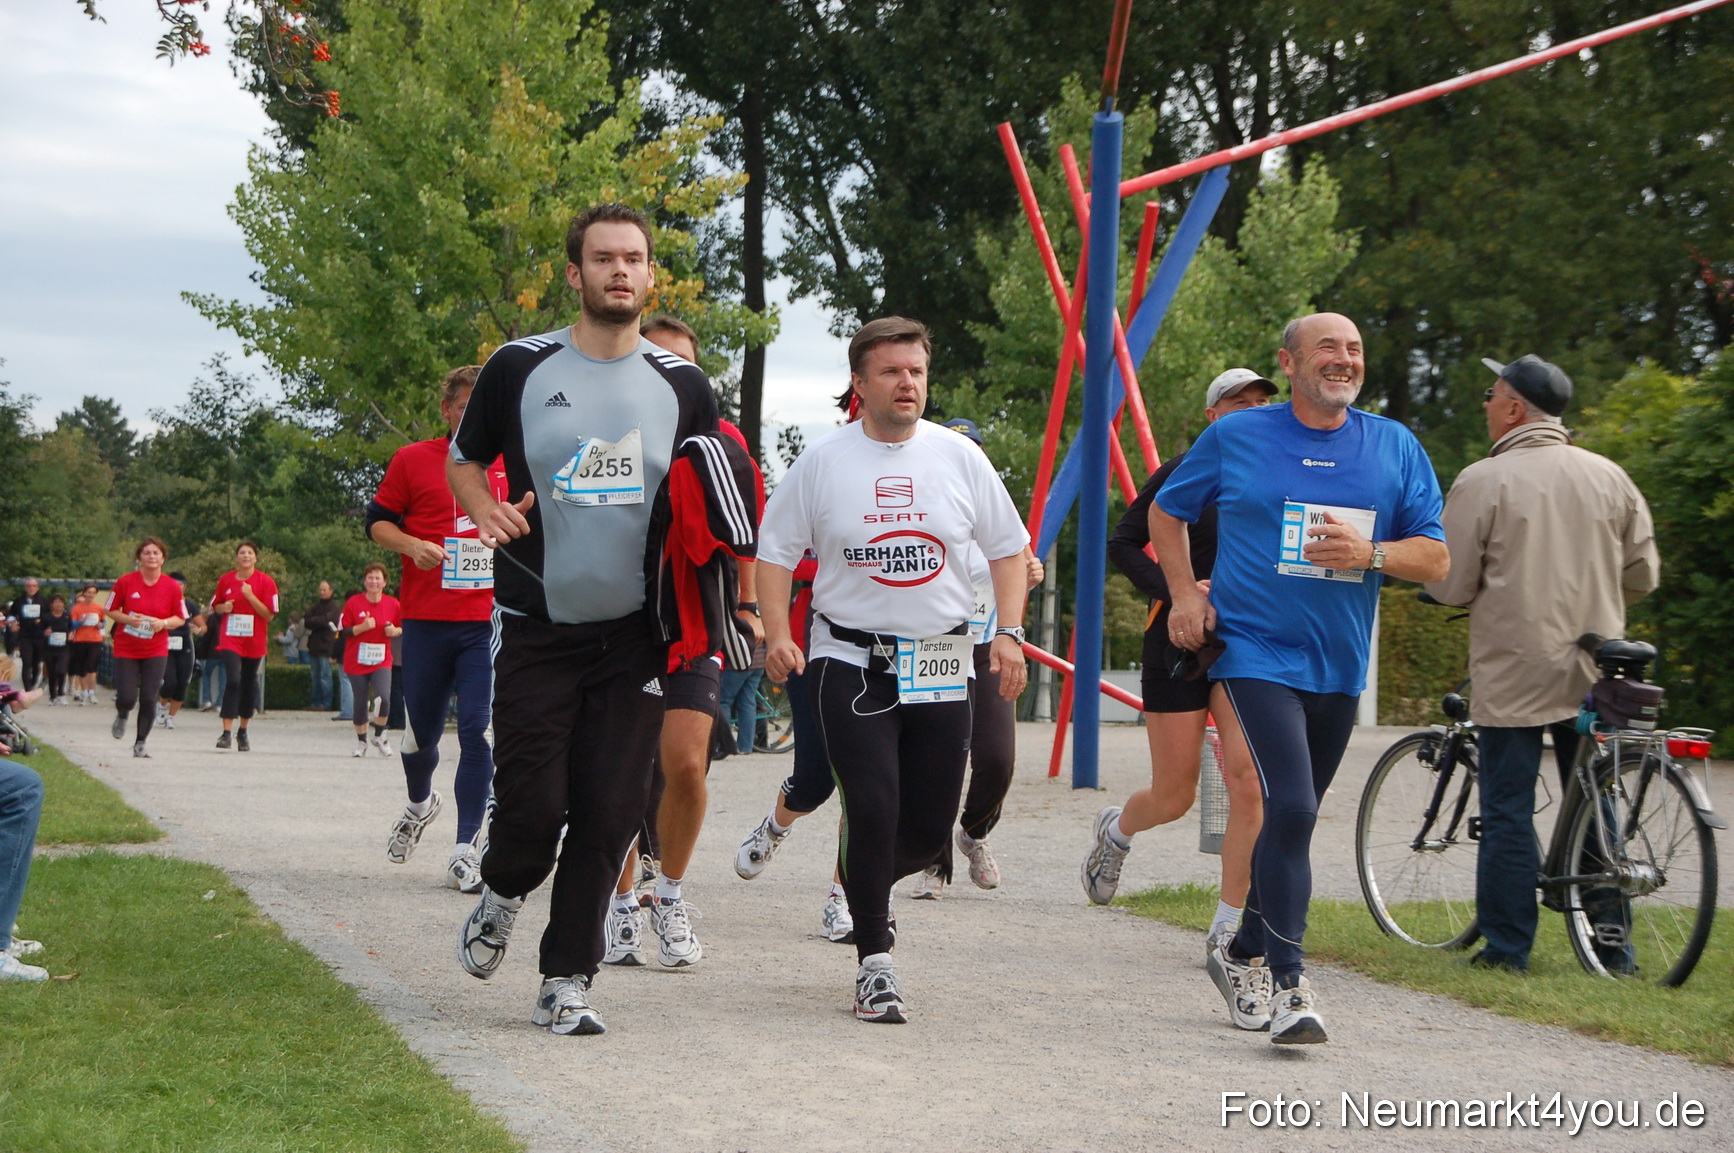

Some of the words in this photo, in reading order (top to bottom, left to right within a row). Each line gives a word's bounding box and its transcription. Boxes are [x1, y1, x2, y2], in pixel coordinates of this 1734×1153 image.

[864, 513, 928, 524] SEAT
[462, 543, 485, 553] Dieter
[843, 544, 927, 561] GERHART
[927, 546, 935, 554] &
[881, 557, 939, 574] JÄNIG
[919, 640, 953, 652] Torsten
[918, 658, 960, 677] 2009
